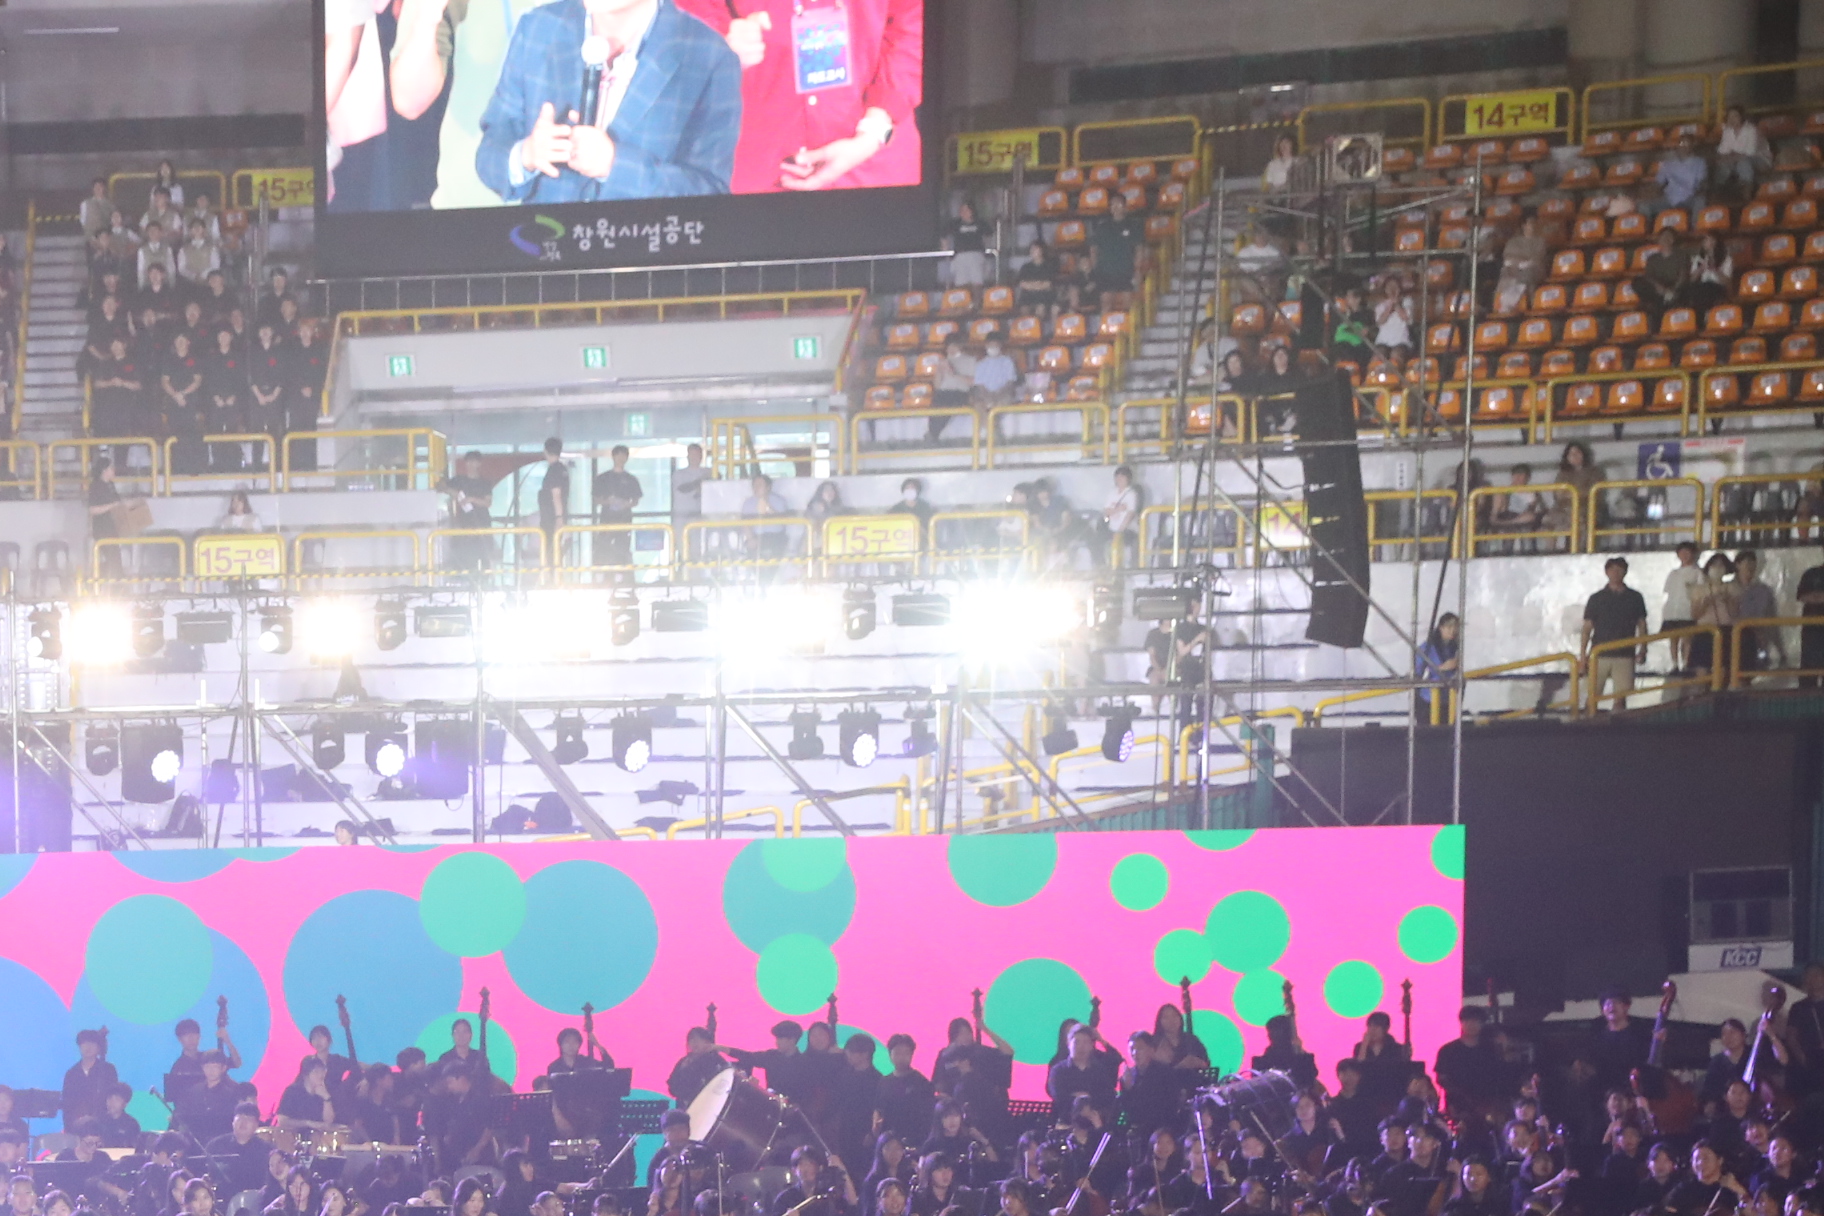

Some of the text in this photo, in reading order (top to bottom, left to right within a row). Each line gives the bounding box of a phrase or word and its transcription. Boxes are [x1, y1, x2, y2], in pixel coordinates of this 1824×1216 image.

[1473, 102, 1549, 129] 14구역
[965, 141, 1032, 165] 15구역
[573, 215, 704, 252] 창원시설공단
[836, 526, 914, 555] 15구역
[201, 547, 275, 574] 15구역
[1724, 948, 1760, 967] KCC
